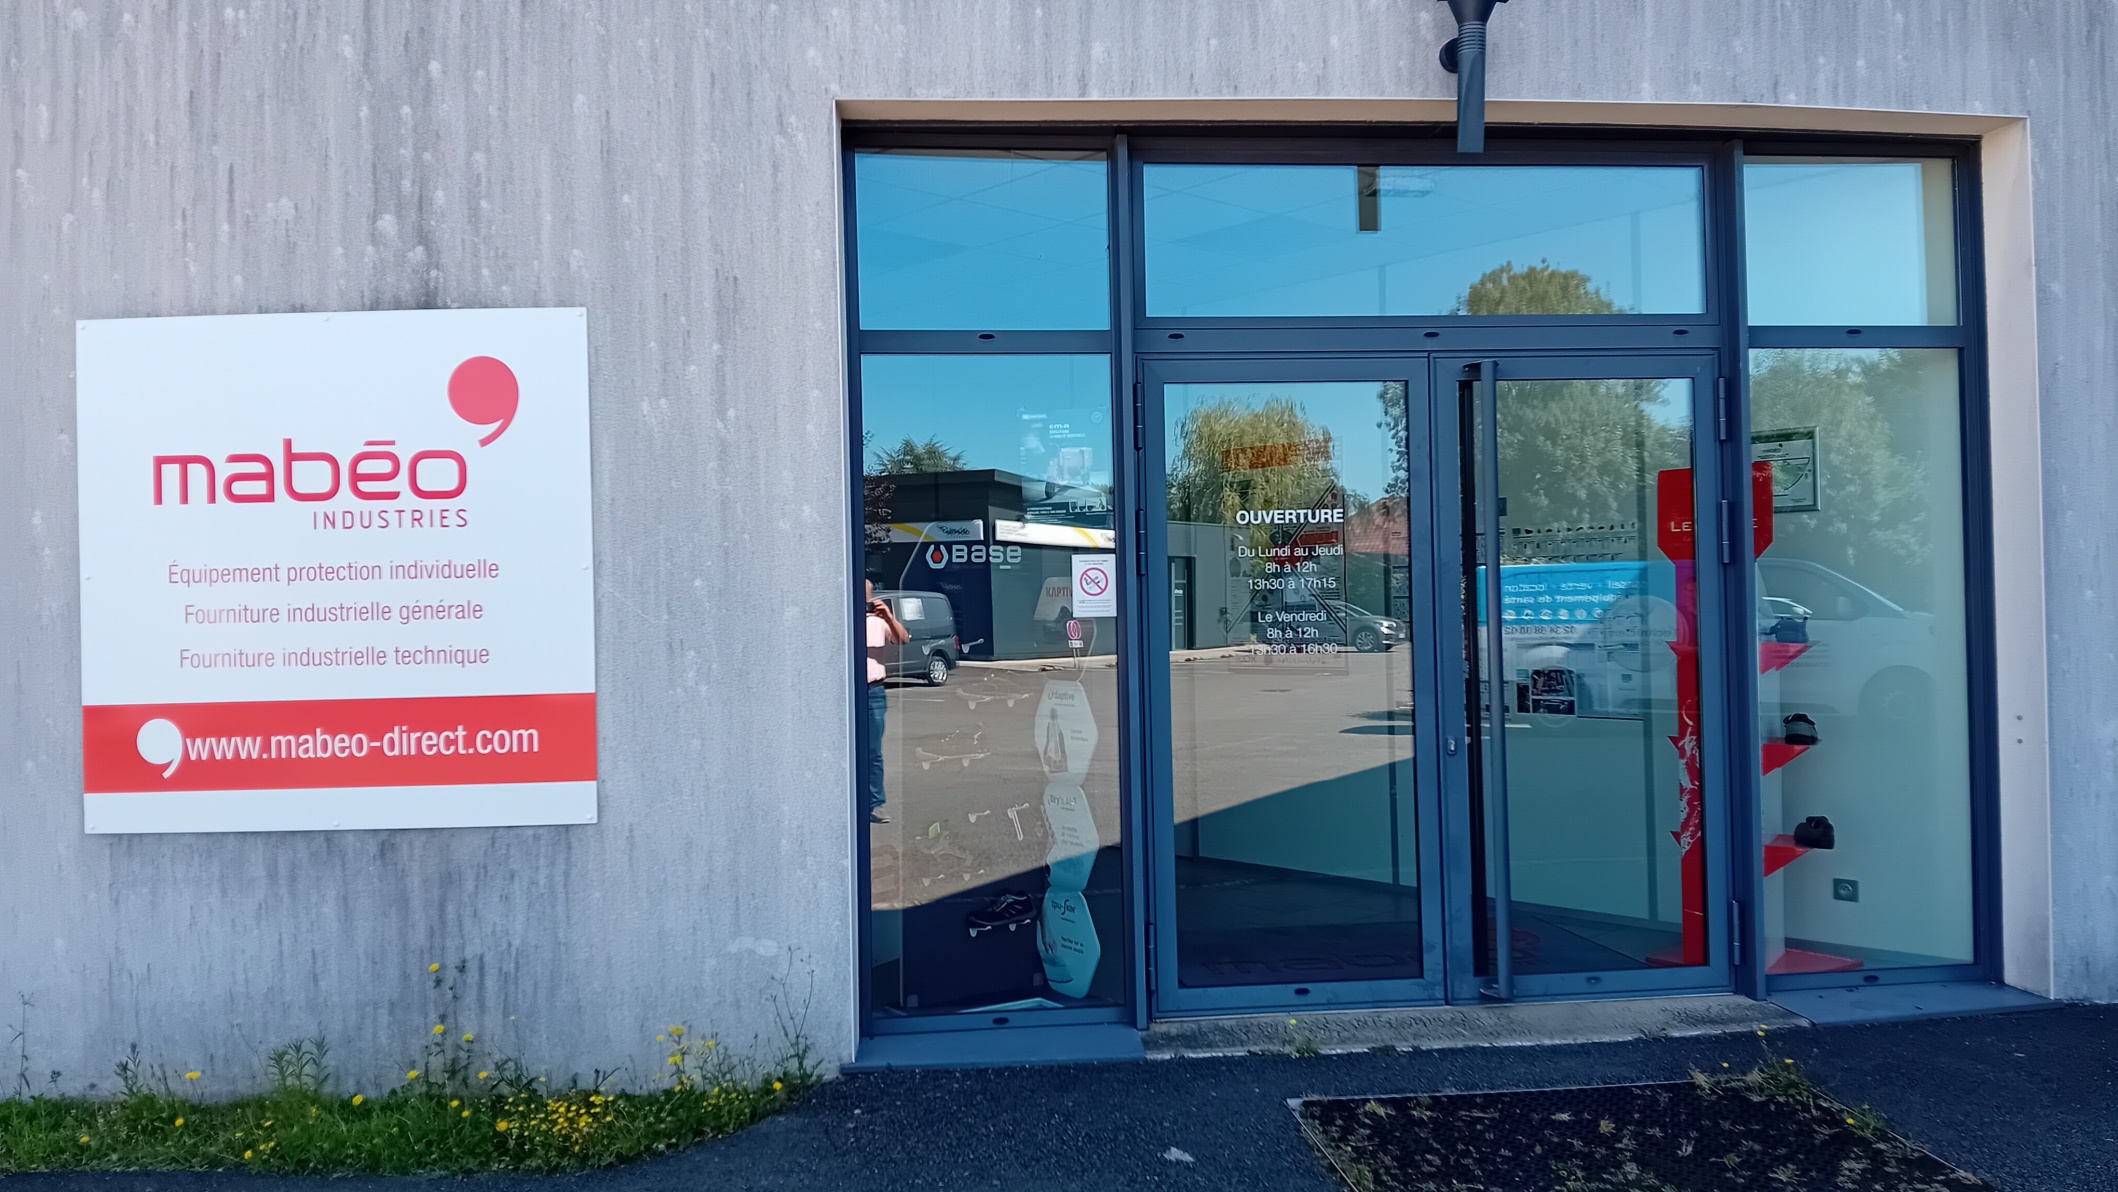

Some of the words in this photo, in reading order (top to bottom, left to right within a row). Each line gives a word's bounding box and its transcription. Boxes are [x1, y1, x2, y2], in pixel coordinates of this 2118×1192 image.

[312, 508, 470, 530] INDUSTRIES
[1236, 509, 1344, 524] OUVERTURE
[1238, 546, 1256, 557] Du
[1258, 545, 1291, 557] Lundi
[1293, 548, 1309, 556] au
[1311, 544, 1344, 556] Jeudi
[167, 559, 281, 588] Équipement
[285, 559, 384, 586] protection
[388, 558, 500, 581] individuelle
[1265, 562, 1281, 573] 8h
[1283, 561, 1293, 573] à
[1296, 562, 1318, 573] 12h
[1248, 578, 1285, 590] 13h30
[1287, 577, 1296, 589] à
[1300, 577, 1336, 589] 17h15
[183, 603, 280, 625] Fourniture
[285, 601, 393, 624] industrielle
[398, 599, 484, 626] générale
[1257, 611, 1274, 623] Le
[1275, 610, 1328, 622] Vendredi
[1266, 627, 1283, 639] 8h
[1285, 626, 1294, 638] à
[1298, 627, 1319, 638] 12h
[1249, 644, 1287, 655] 13h30
[1289, 643, 1298, 655] à
[1301, 643, 1338, 655] 16h30
[178, 647, 275, 670] Fourniture
[281, 645, 388, 668] industrielle
[393, 644, 491, 668] technique
[184, 724, 540, 762] www.mabeo-direct.com
